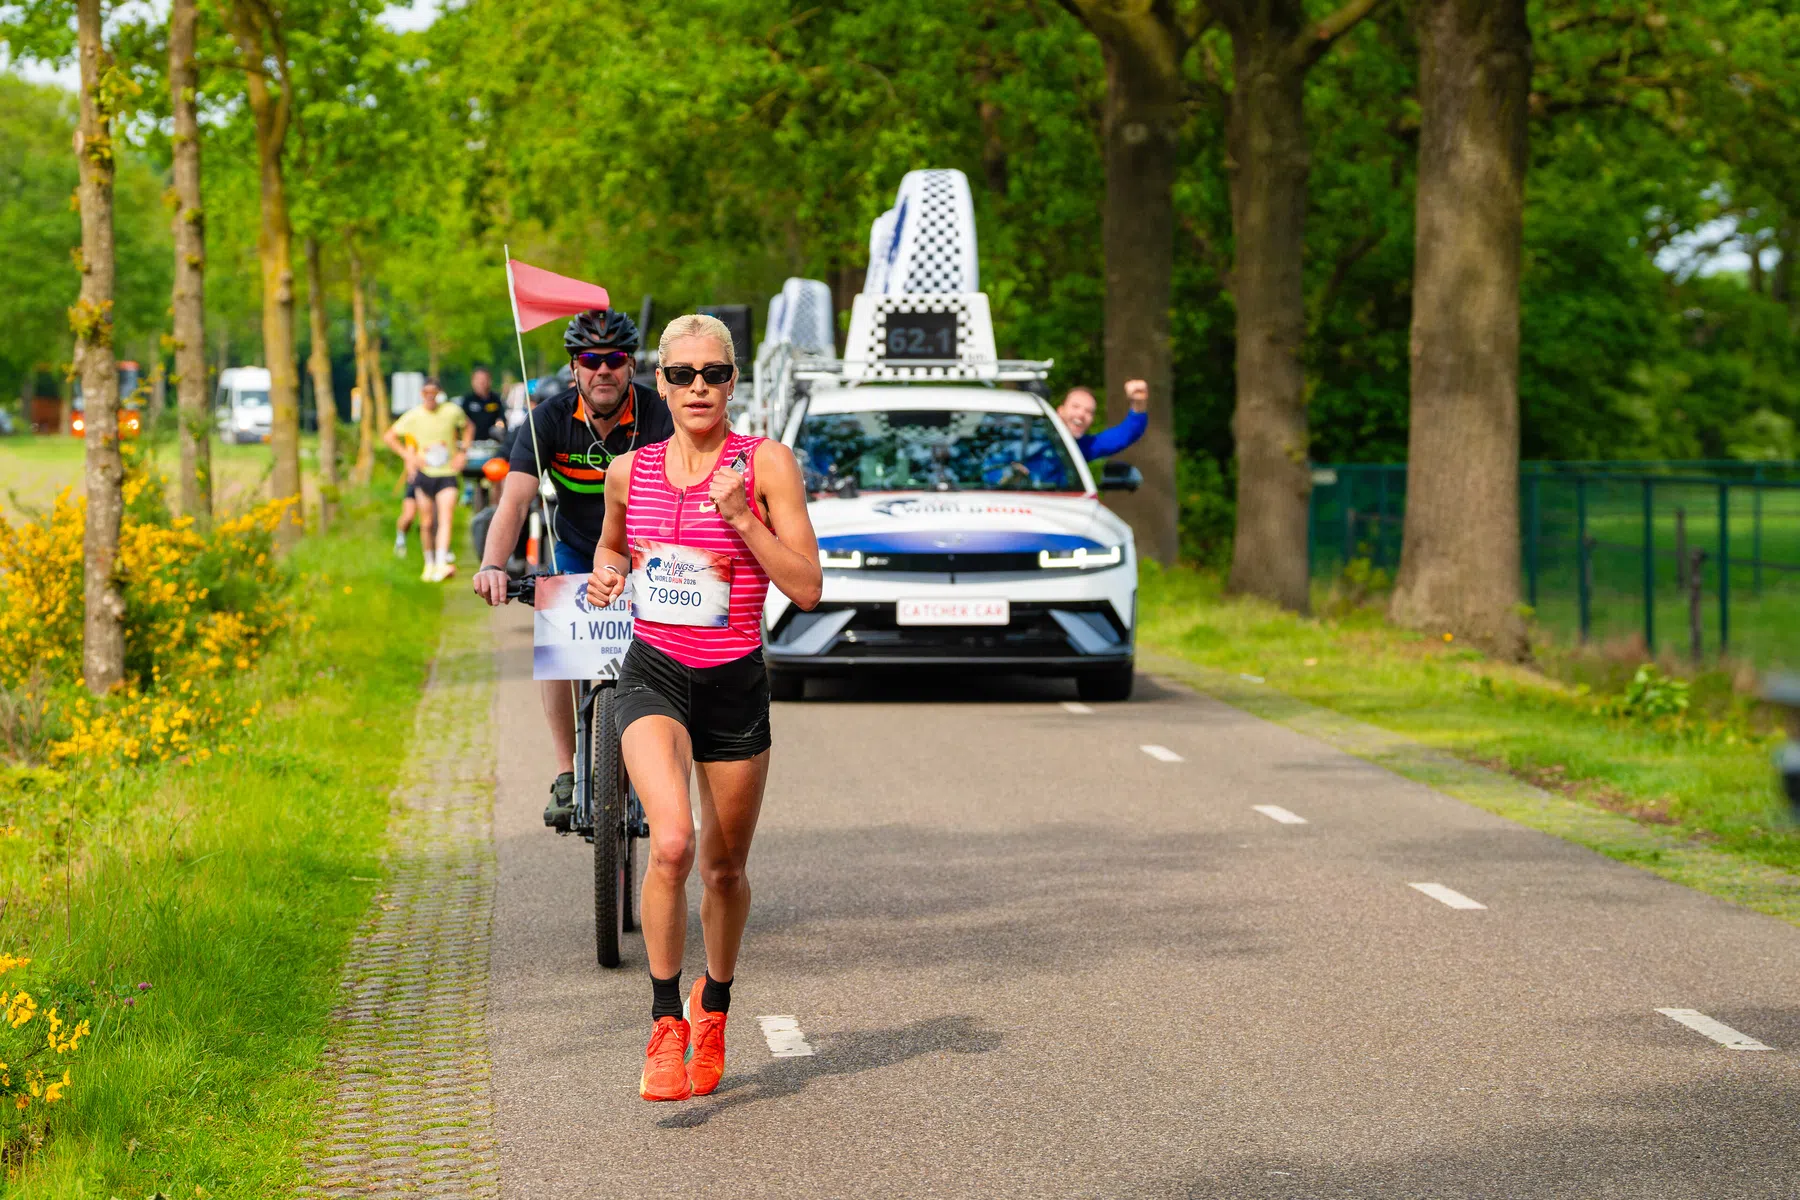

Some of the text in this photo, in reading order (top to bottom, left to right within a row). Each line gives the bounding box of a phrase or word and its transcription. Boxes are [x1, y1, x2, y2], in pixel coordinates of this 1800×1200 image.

[888, 327, 952, 354] 62.1
[663, 560, 695, 572] WINGS
[666, 569, 685, 577] LIFE
[648, 586, 702, 607] 79990
[903, 603, 1004, 617] CATCHER CAR
[569, 621, 634, 640] 1. WOM
[600, 646, 622, 655] BREDA
